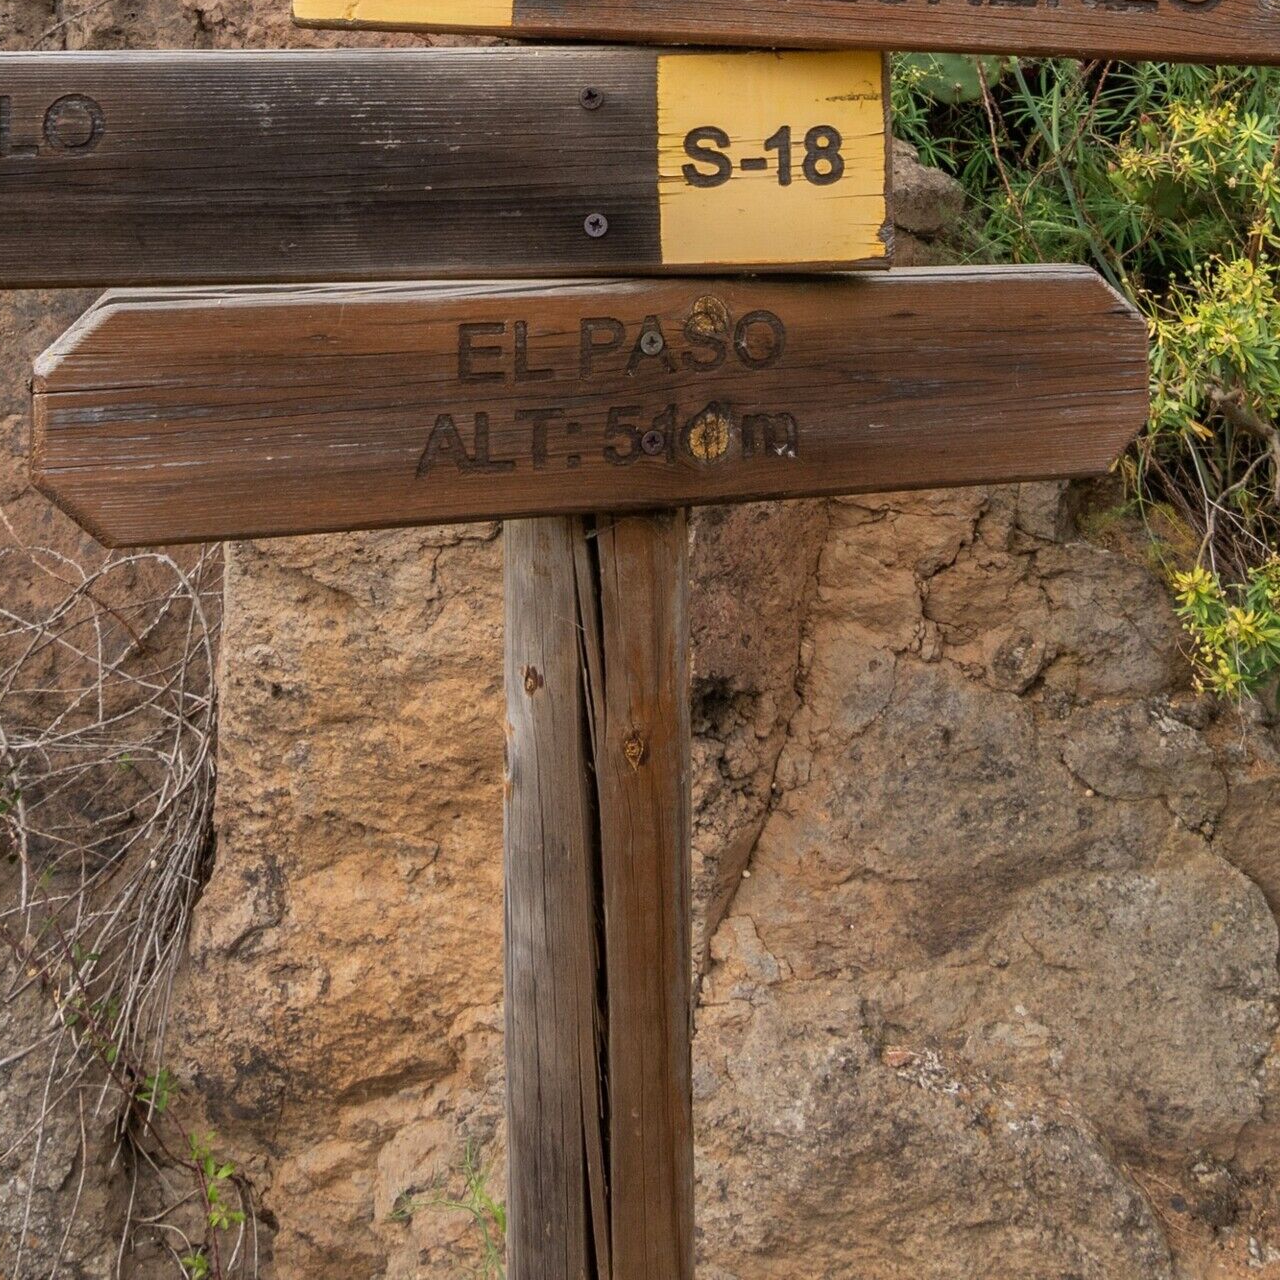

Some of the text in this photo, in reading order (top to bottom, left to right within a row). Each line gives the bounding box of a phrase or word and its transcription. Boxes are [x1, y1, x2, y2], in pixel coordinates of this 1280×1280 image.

[681, 124, 845, 189] S-18
[457, 309, 787, 385] EL PASO
